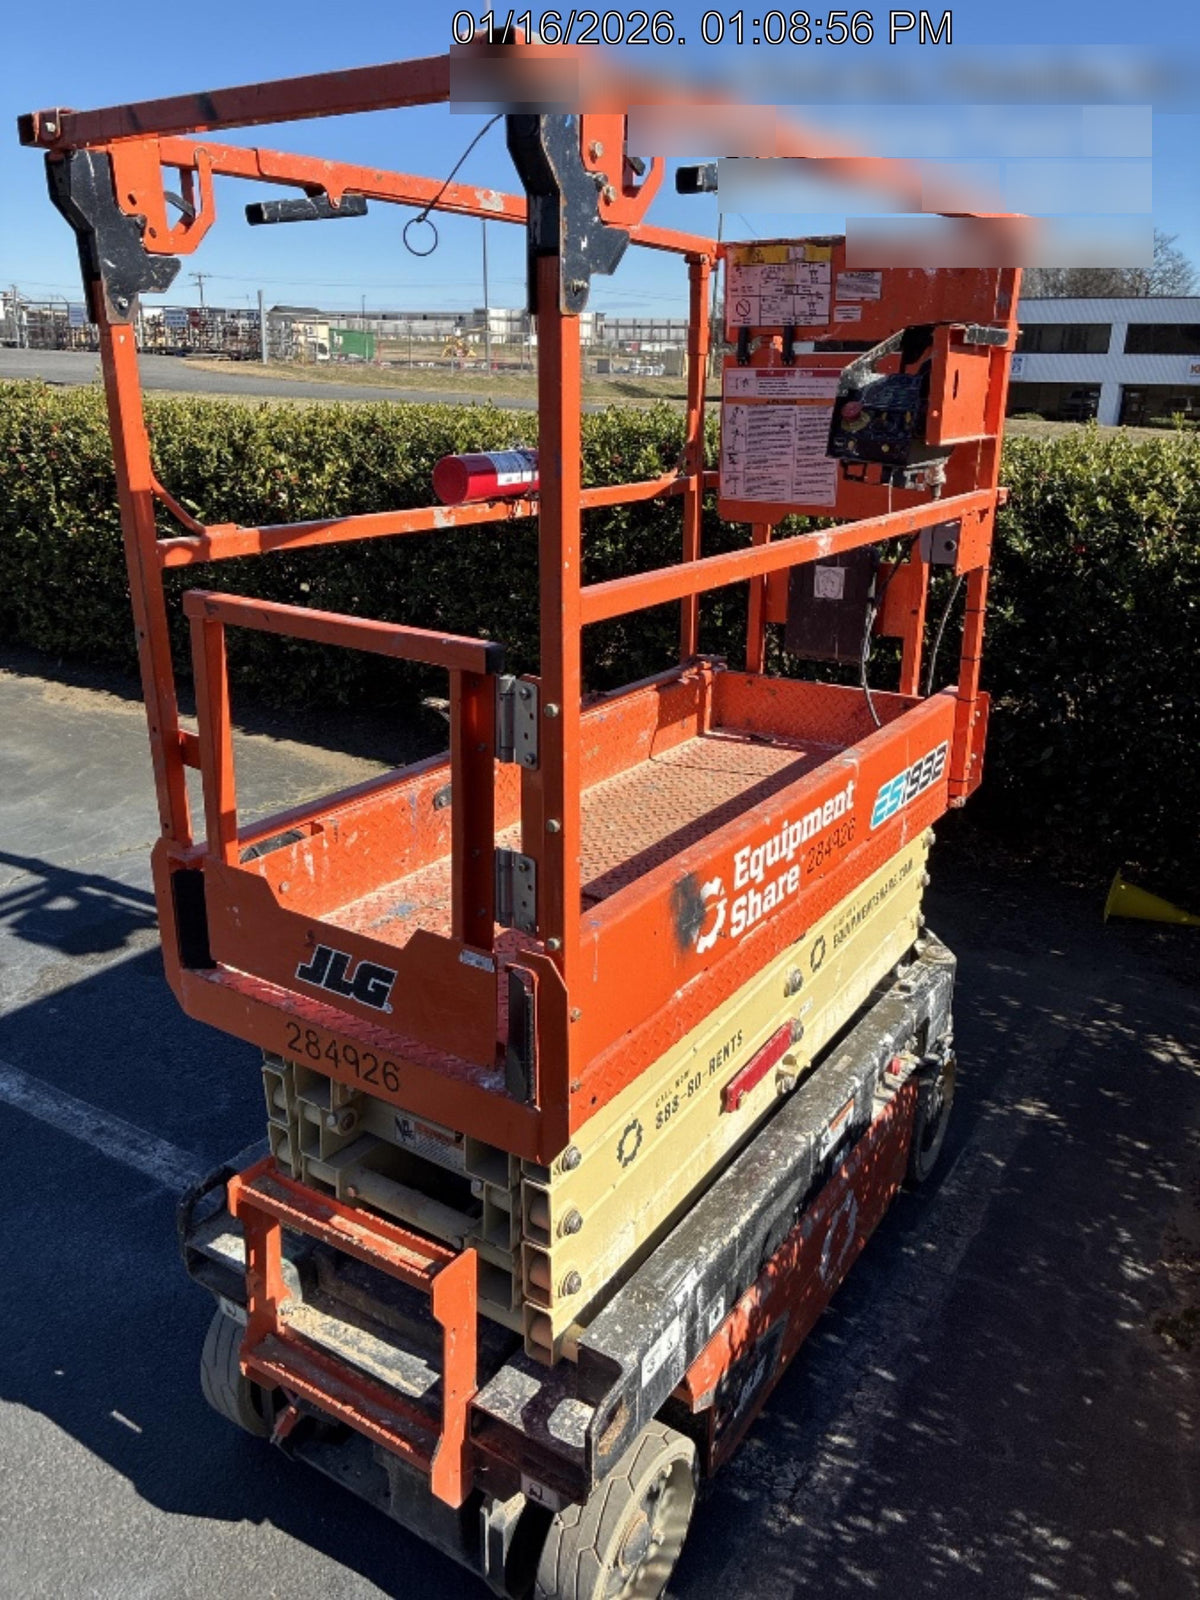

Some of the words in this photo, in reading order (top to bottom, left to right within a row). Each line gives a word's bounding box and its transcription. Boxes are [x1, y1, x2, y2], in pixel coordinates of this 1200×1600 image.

[870, 739, 949, 831] ES1932
[733, 780, 855, 892] Equipment
[806, 816, 857, 874] 284926
[729, 863, 800, 938] Share
[294, 943, 399, 1010] JLG
[285, 1021, 401, 1093] 284926
